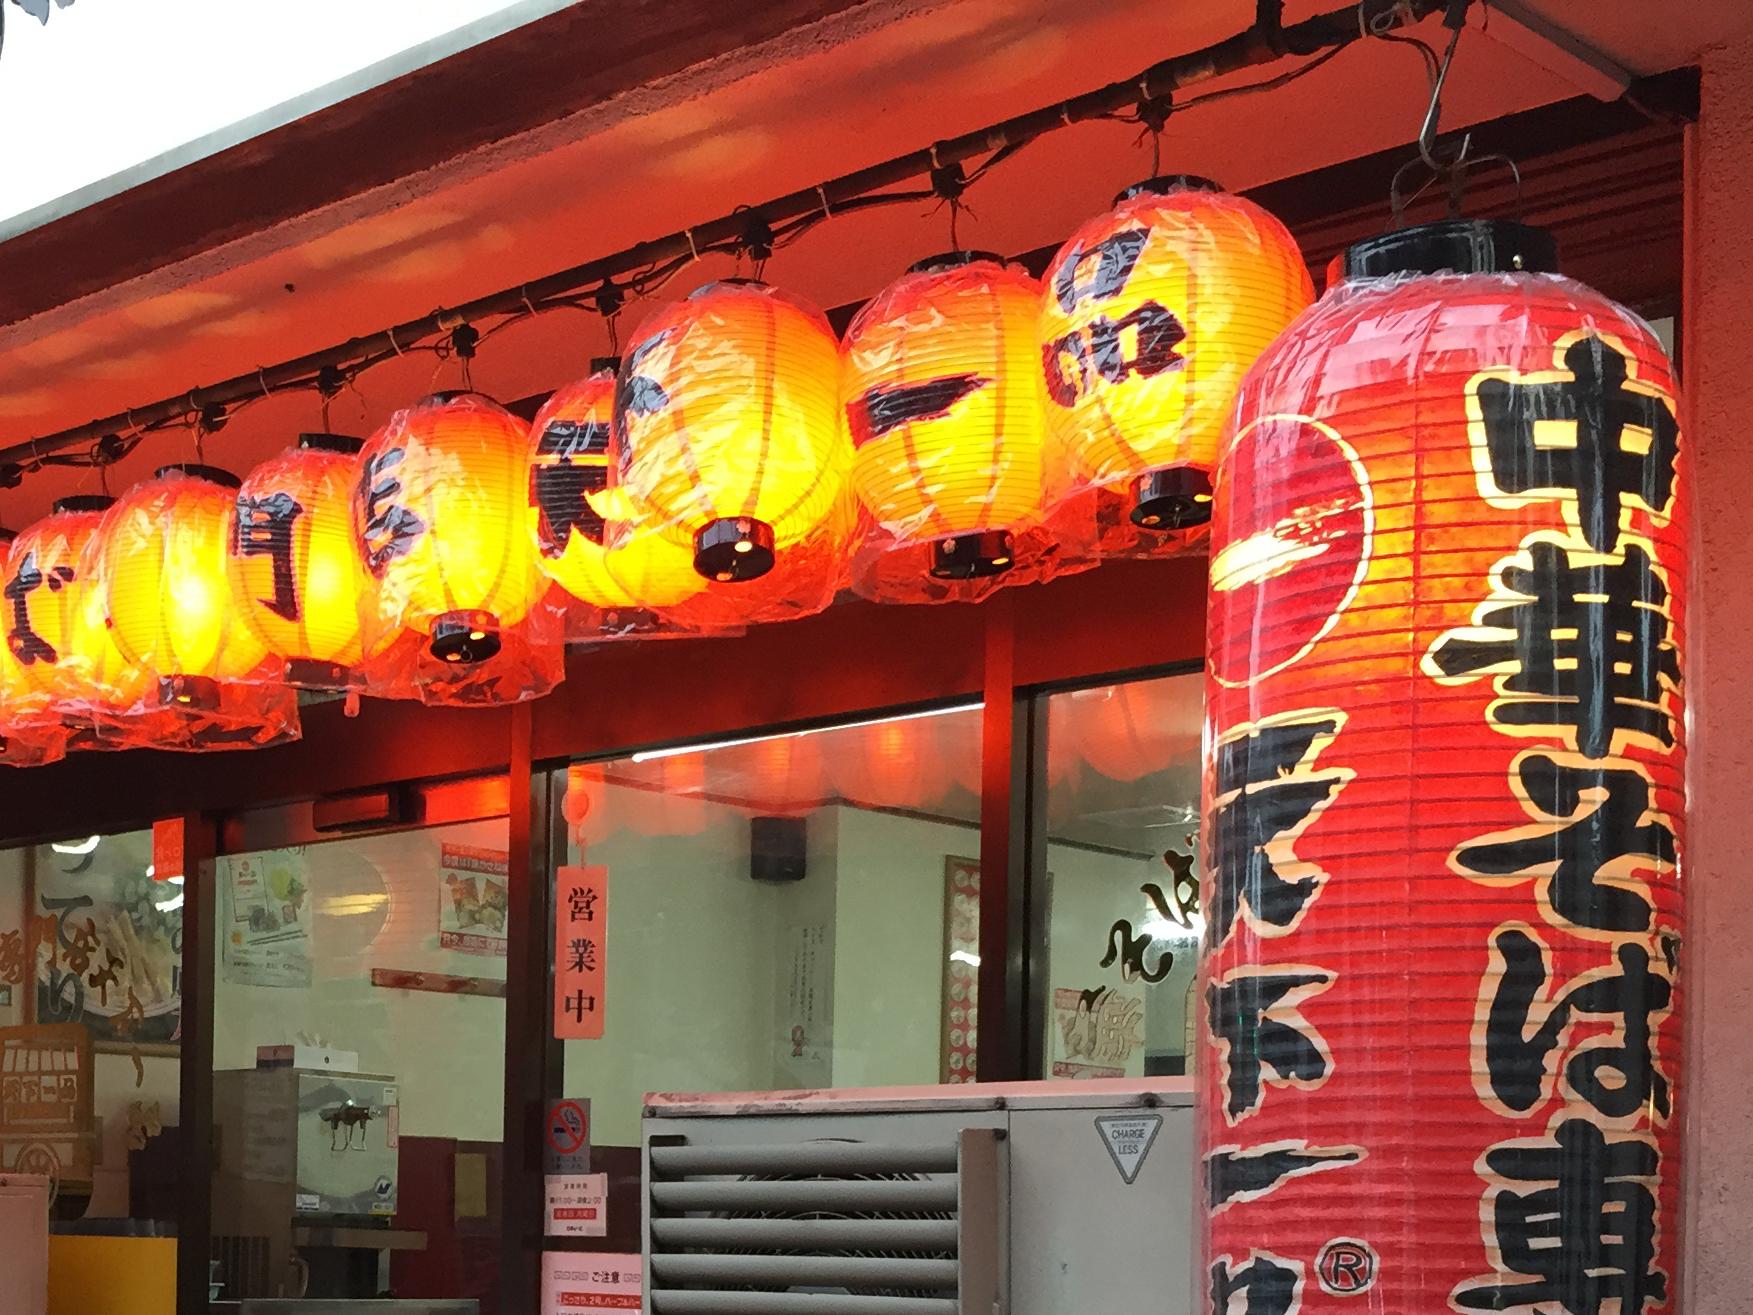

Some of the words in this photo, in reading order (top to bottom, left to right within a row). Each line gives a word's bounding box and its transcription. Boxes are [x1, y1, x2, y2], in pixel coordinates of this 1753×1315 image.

[564, 886, 598, 1024] 営業中
[1111, 1128, 1145, 1140] CHARGE
[1118, 1144, 1139, 1155] LESS
[591, 1270, 620, 1284] ご注意
